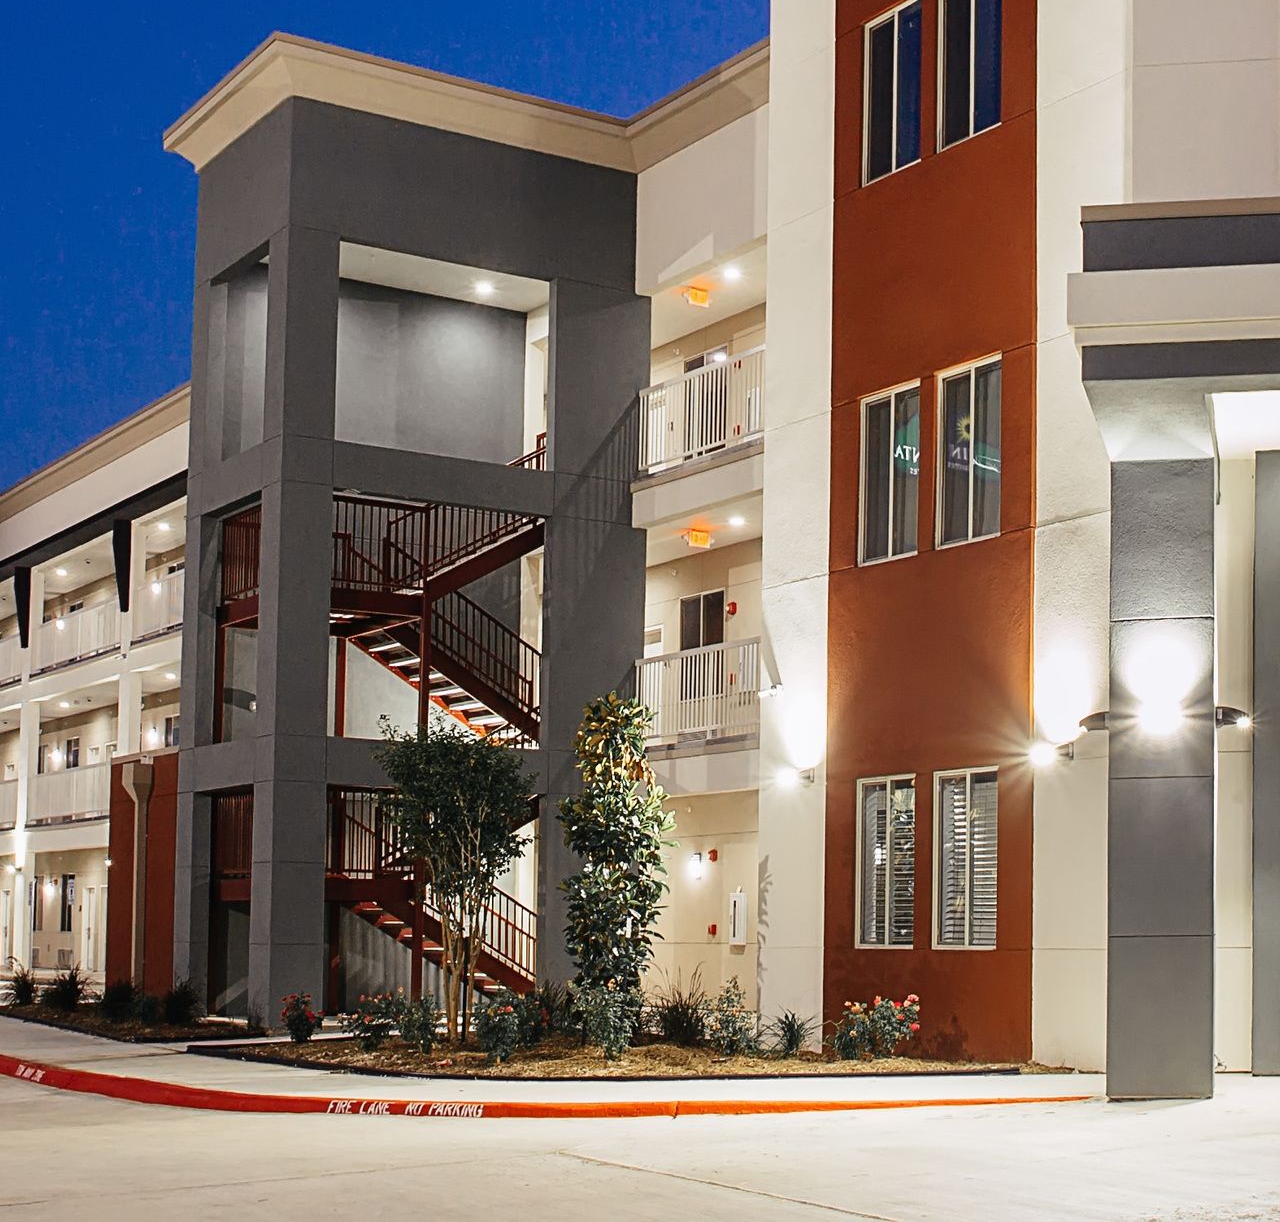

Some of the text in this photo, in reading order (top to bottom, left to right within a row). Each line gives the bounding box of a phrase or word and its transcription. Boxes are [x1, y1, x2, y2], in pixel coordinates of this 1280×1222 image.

[326, 1099, 484, 1118] FIRE LANE NO PARKING
